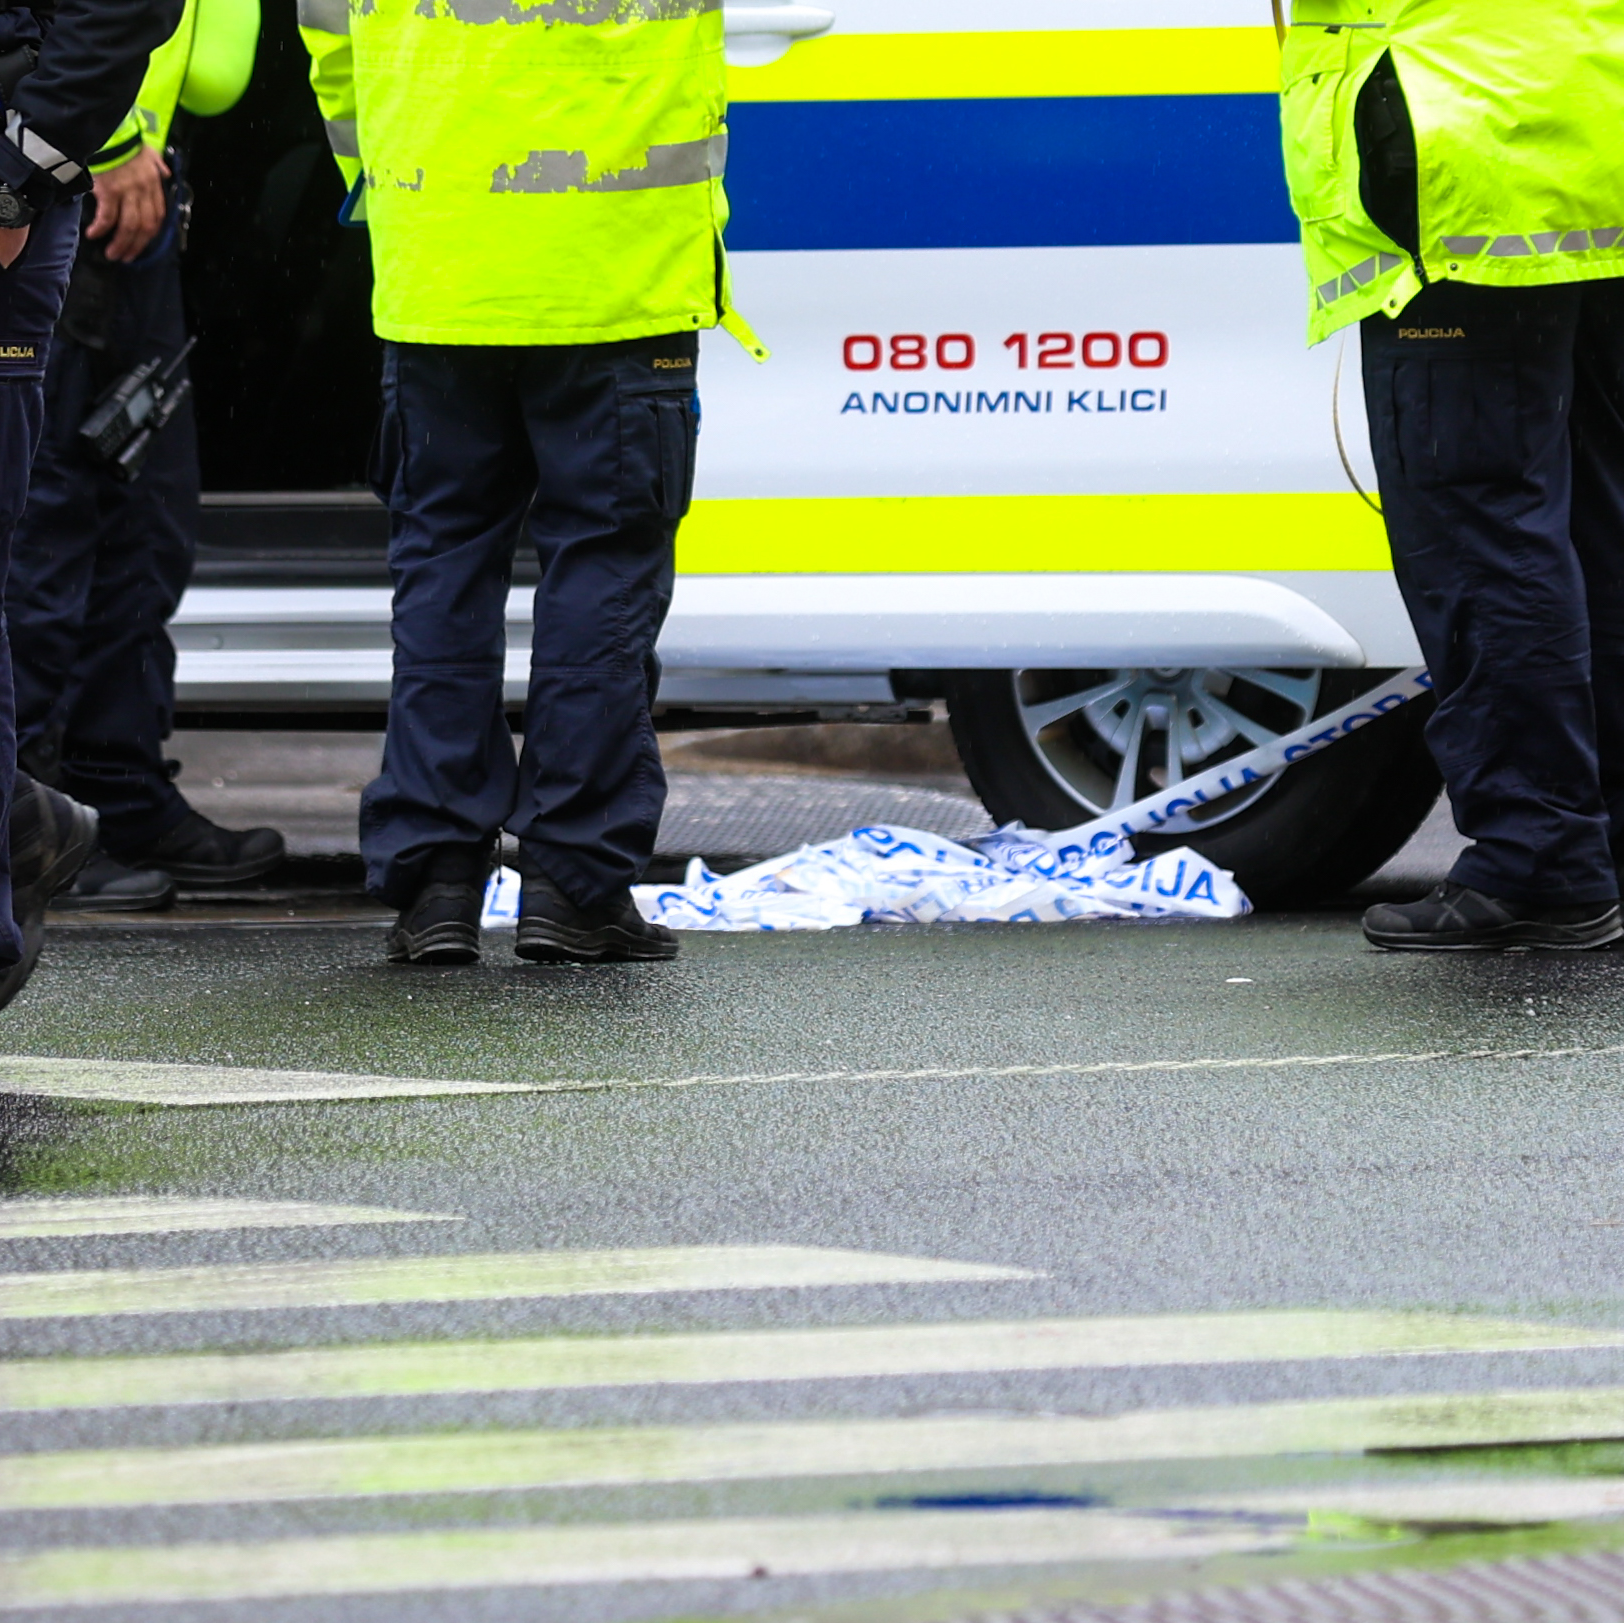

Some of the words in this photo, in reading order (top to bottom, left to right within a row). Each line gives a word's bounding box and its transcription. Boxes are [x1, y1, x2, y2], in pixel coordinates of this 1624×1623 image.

[1398, 327, 1466, 339] POLICIJA
[842, 333, 977, 372] 080
[1002, 330, 1170, 370] 1200
[840, 390, 1053, 415] ANONIMNI
[1067, 388, 1168, 413] KLICI
